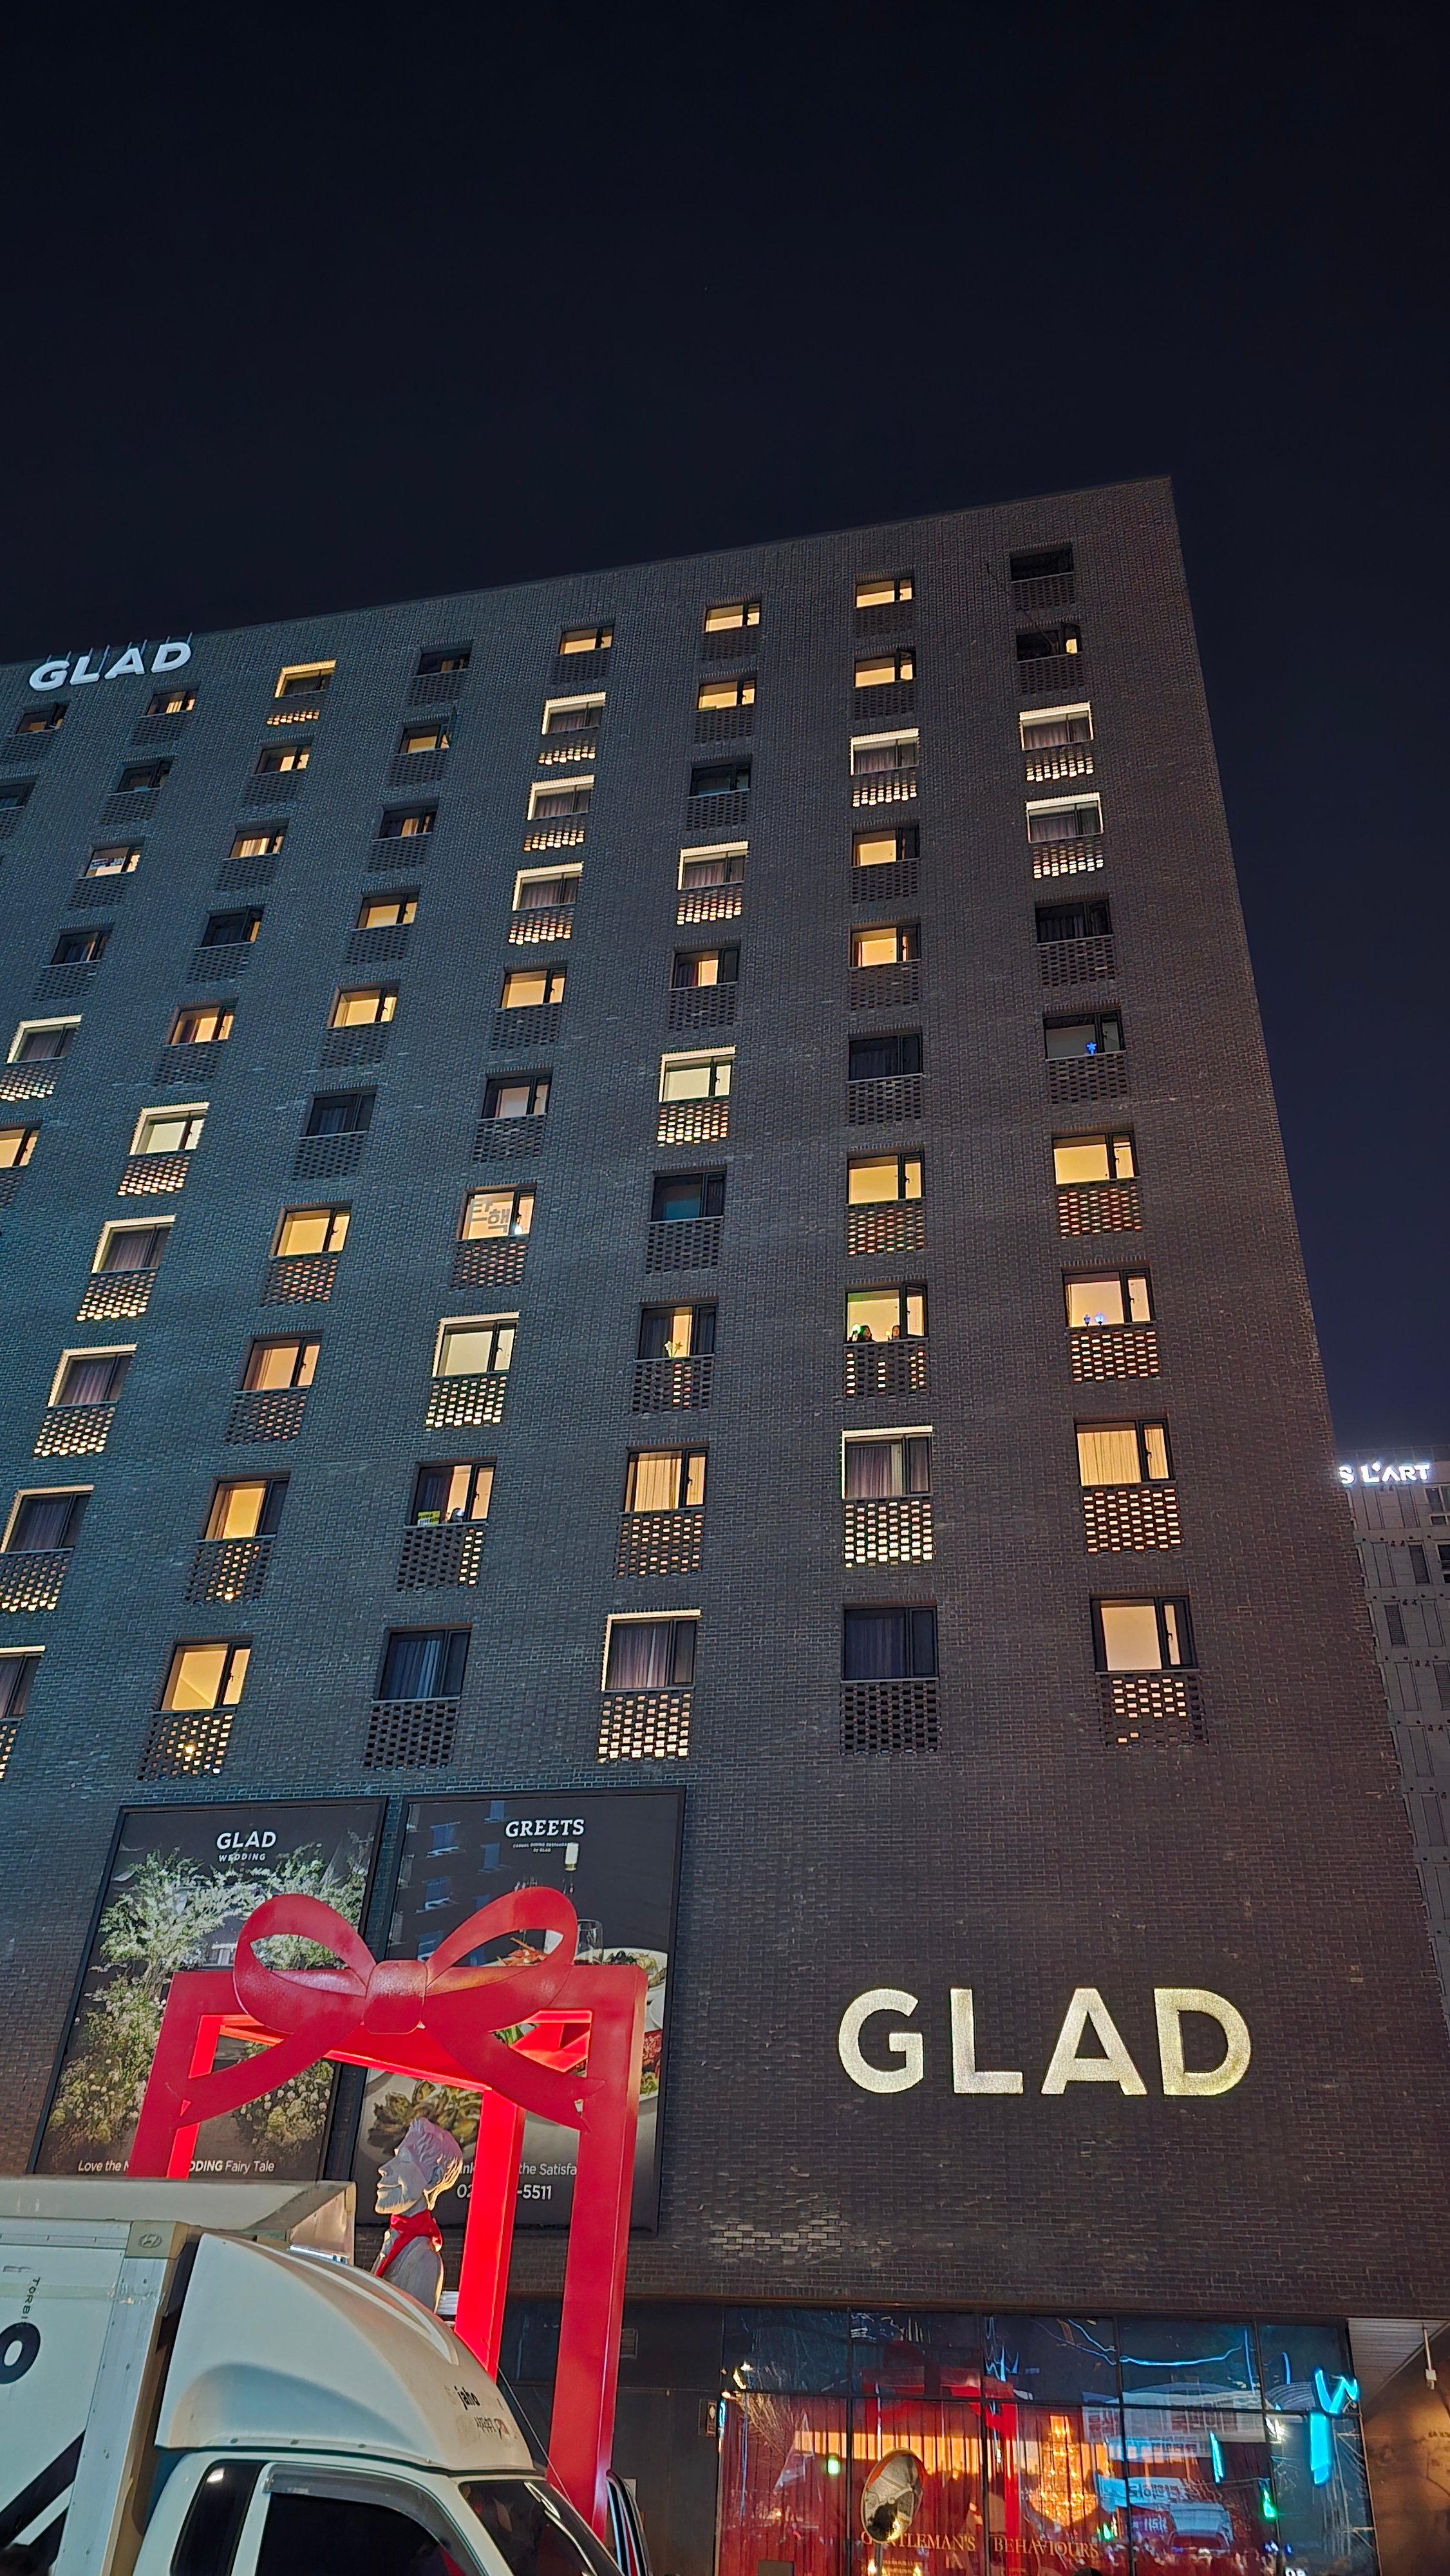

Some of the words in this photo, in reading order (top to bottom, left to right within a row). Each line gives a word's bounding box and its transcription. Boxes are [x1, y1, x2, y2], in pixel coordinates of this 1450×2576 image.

[29, 642, 192, 691] GLAD
[505, 1819, 585, 1837] GREETS
[216, 1831, 277, 1850] GLAD
[219, 1853, 266, 1862] WEDDING
[838, 1988, 1252, 2096] GLAD
[78, 2159, 102, 2172] Love
[105, 2159, 121, 2172] the
[225, 2160, 250, 2175] Fairy
[254, 2160, 275, 2172] Tale
[519, 2163, 537, 2175] the
[539, 2163, 577, 2175] Satisfa
[21, 2277, 41, 2325] TORBI
[861, 2531, 976, 2552] GTLEMAN'S
[993, 2536, 1099, 2559] BEHAVIOURS
